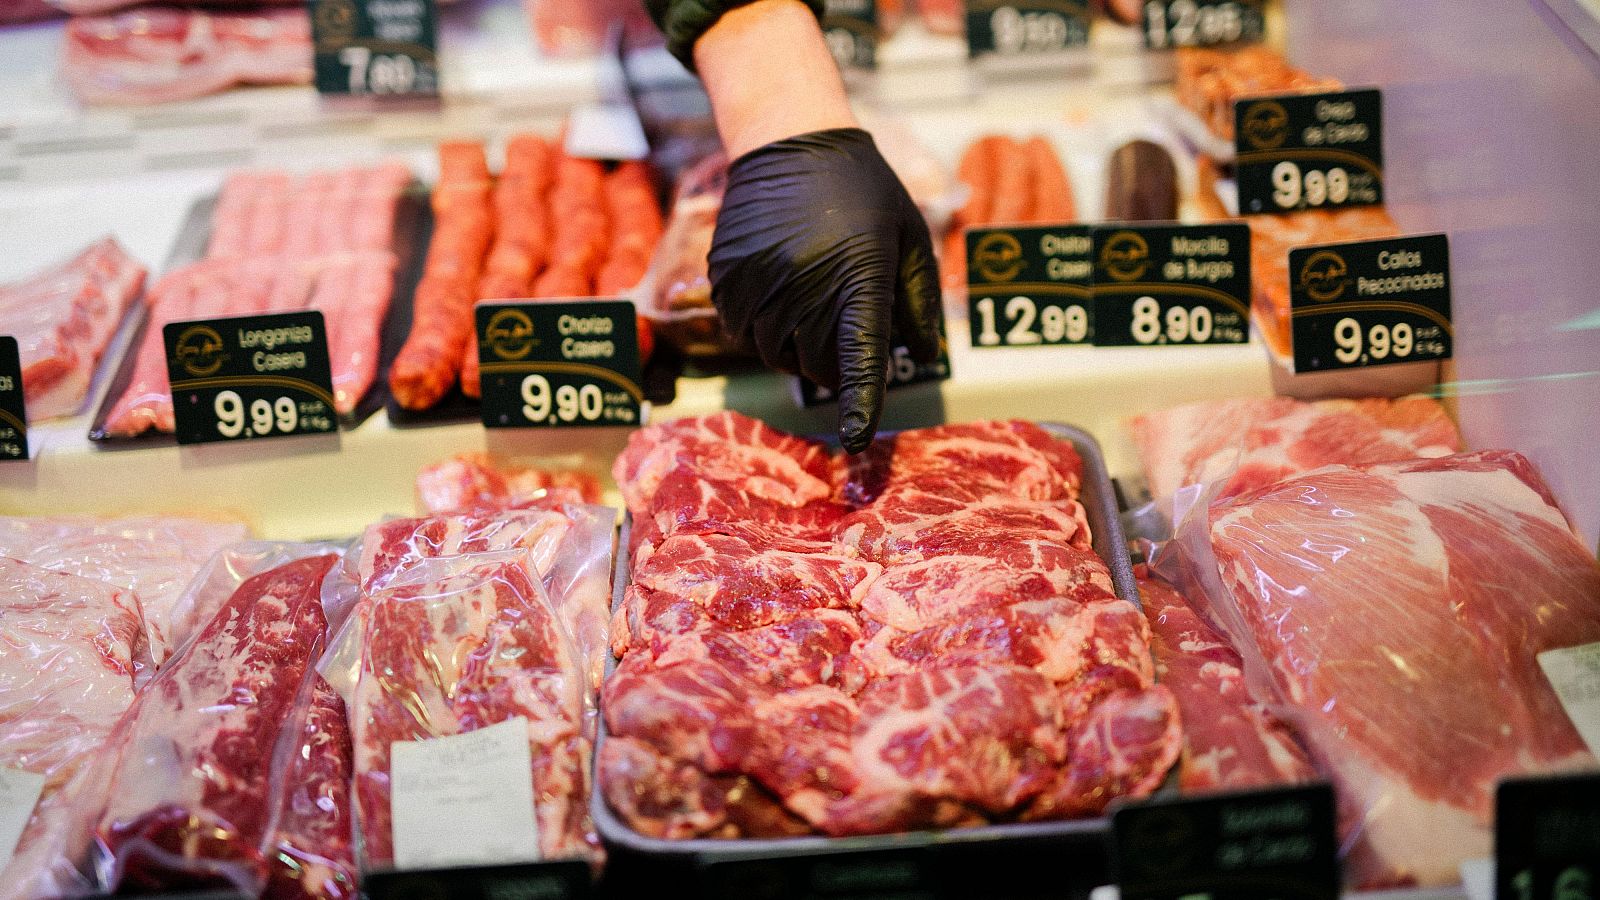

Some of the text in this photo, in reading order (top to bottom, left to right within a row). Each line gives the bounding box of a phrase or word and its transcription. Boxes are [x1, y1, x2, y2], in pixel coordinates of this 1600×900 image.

[1377, 251, 1422, 271] Callos
[1357, 271, 1445, 296] Precocinados
[238, 325, 314, 350] Longaniza
[252, 351, 307, 372] Casera
